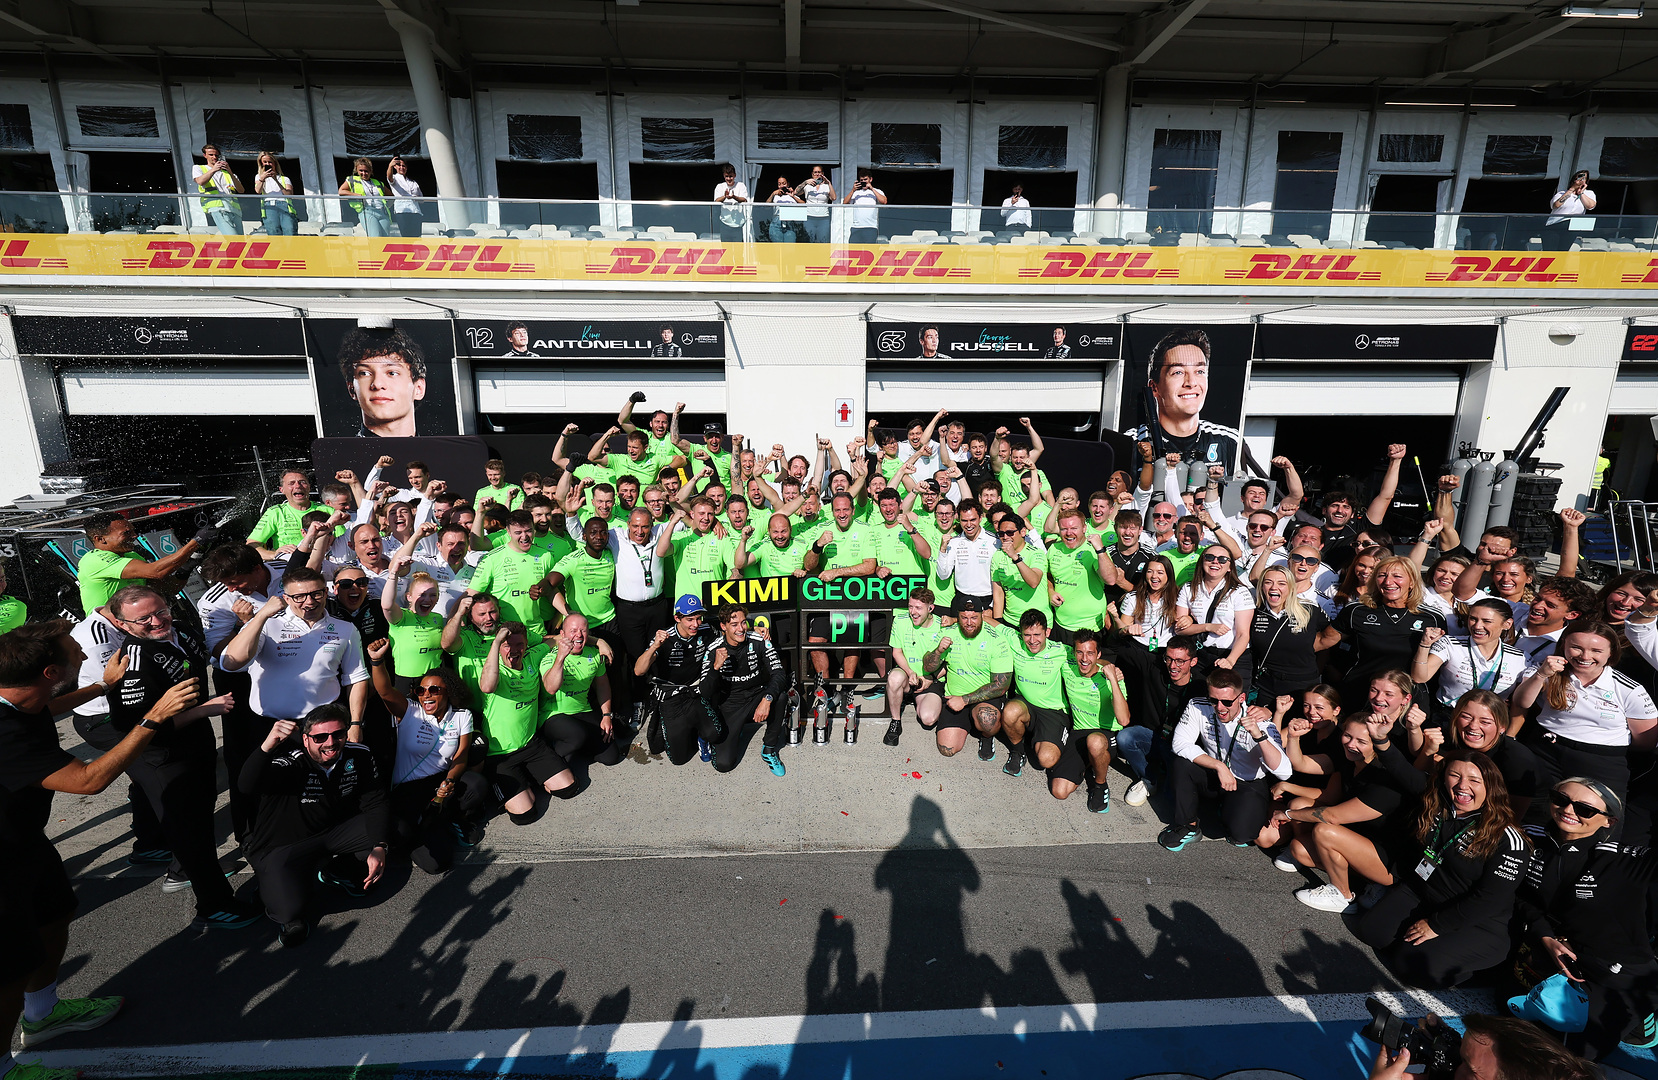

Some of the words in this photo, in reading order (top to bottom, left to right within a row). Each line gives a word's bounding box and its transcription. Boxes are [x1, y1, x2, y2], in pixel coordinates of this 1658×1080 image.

[147, 241, 281, 270] DHL
[382, 243, 511, 272] DHL
[609, 246, 733, 275] DHL
[827, 250, 949, 277] DHL
[1039, 252, 1157, 278] DHL
[1245, 254, 1359, 280] DHL
[1445, 256, 1557, 282] DHL
[465, 327, 494, 349] 12
[532, 340, 652, 349] ANTONELLI
[877, 330, 906, 352] 63
[950, 342, 1039, 351] RUSSELL
[1631, 334, 1658, 351] 22
[710, 577, 789, 606] KIMI
[58, 608, 82, 624] IW
[1503, 860, 1519, 869] IWC
